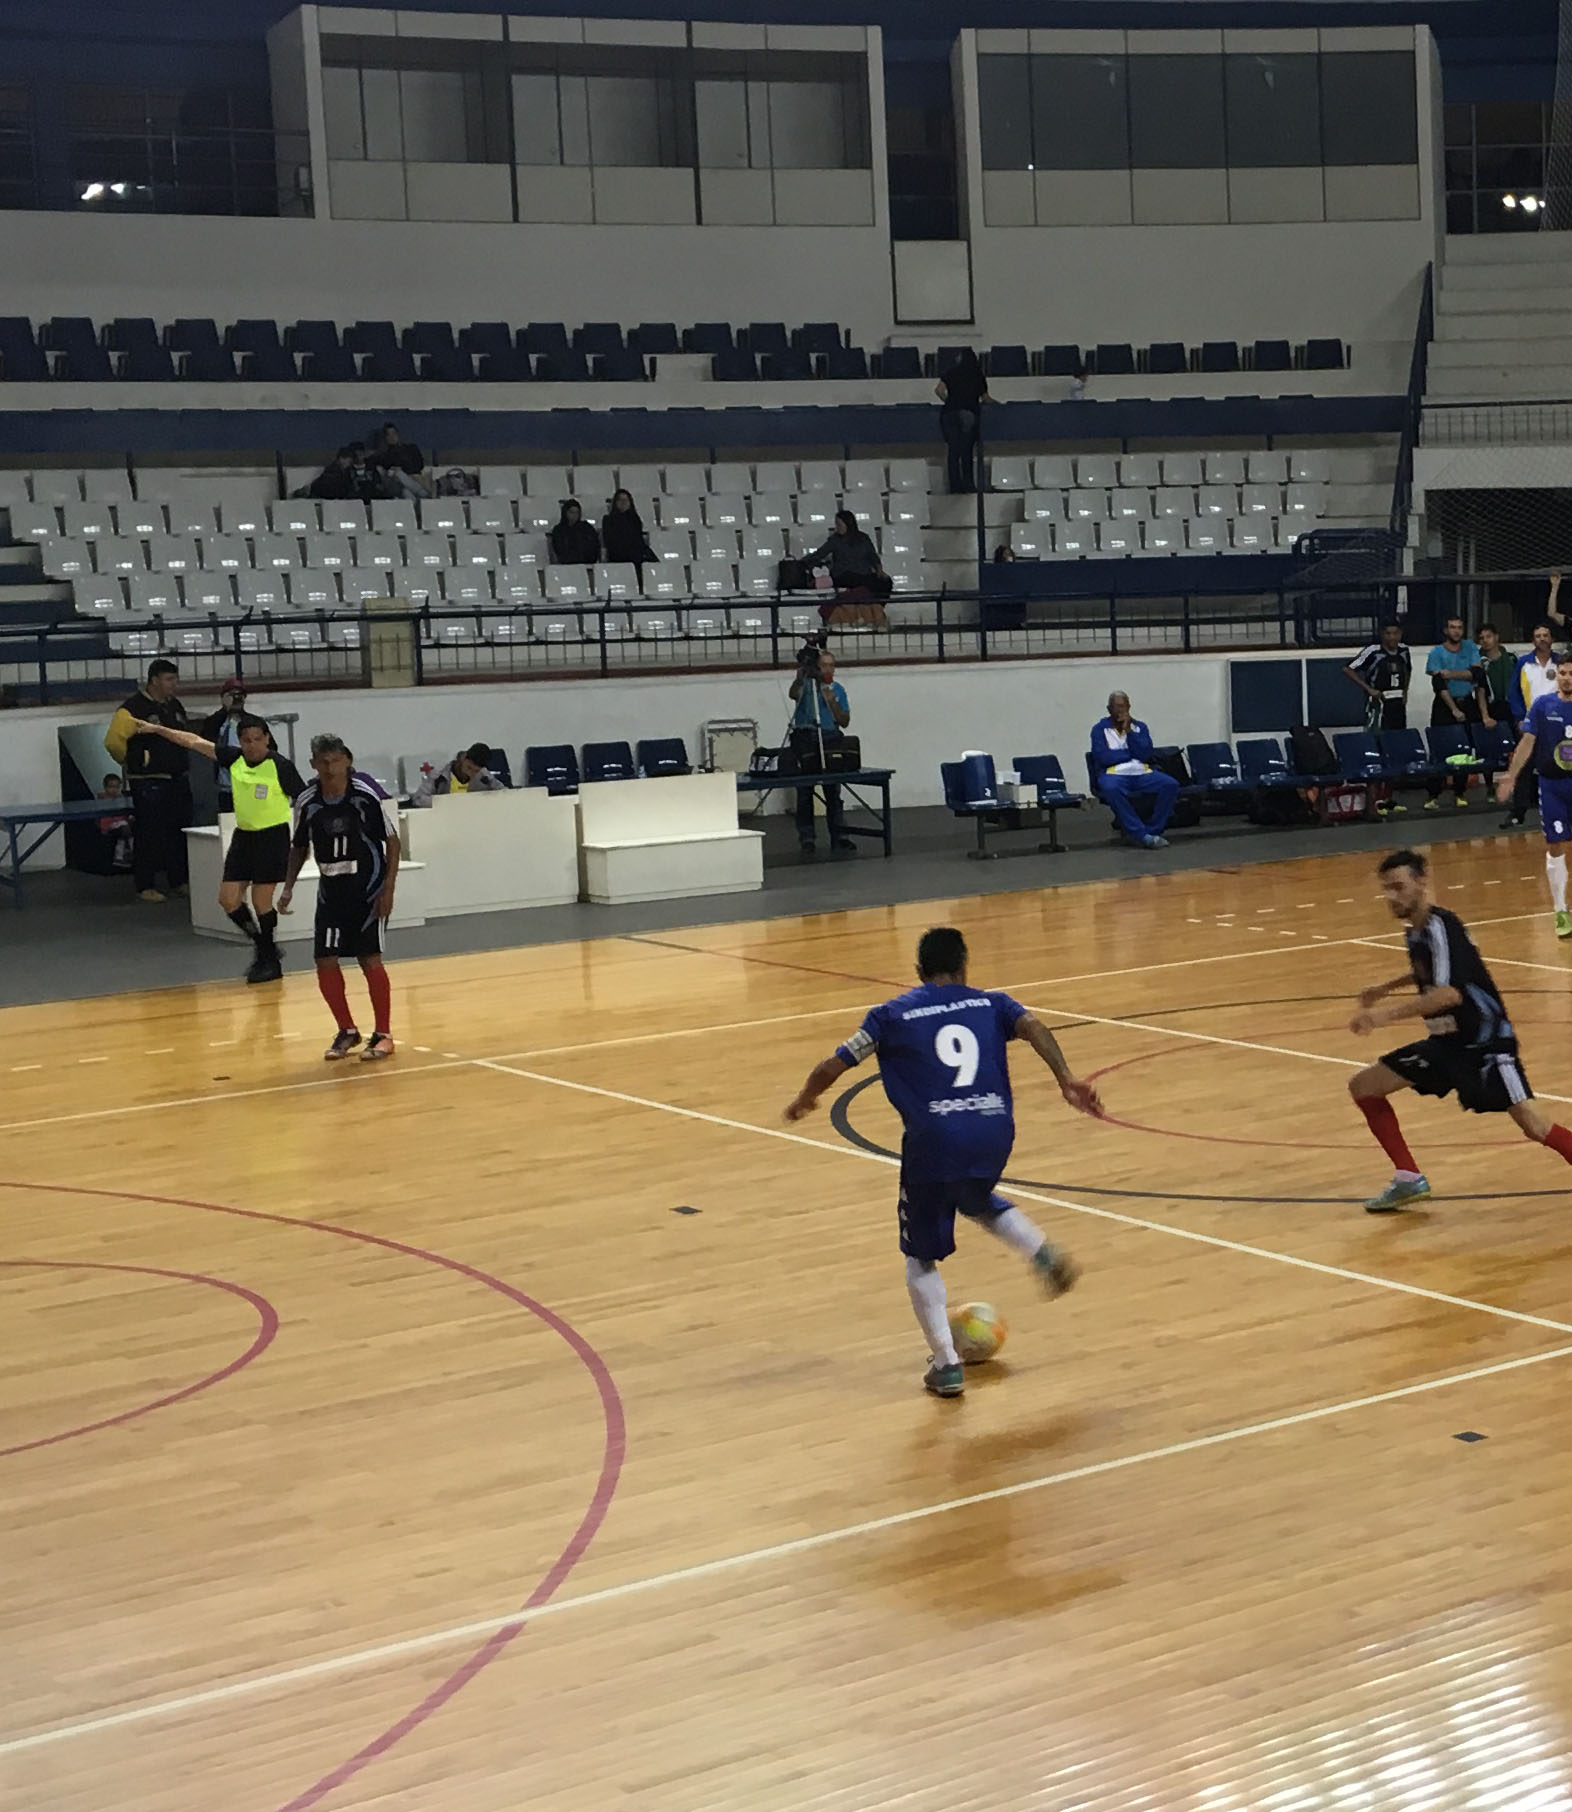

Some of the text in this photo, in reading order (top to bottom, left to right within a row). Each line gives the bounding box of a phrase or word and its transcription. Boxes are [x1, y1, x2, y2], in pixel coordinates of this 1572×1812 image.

[1553, 820, 1564, 834] 8
[333, 836, 348, 858] 11
[325, 927, 340, 948] 11
[934, 1024, 980, 1087] 9
